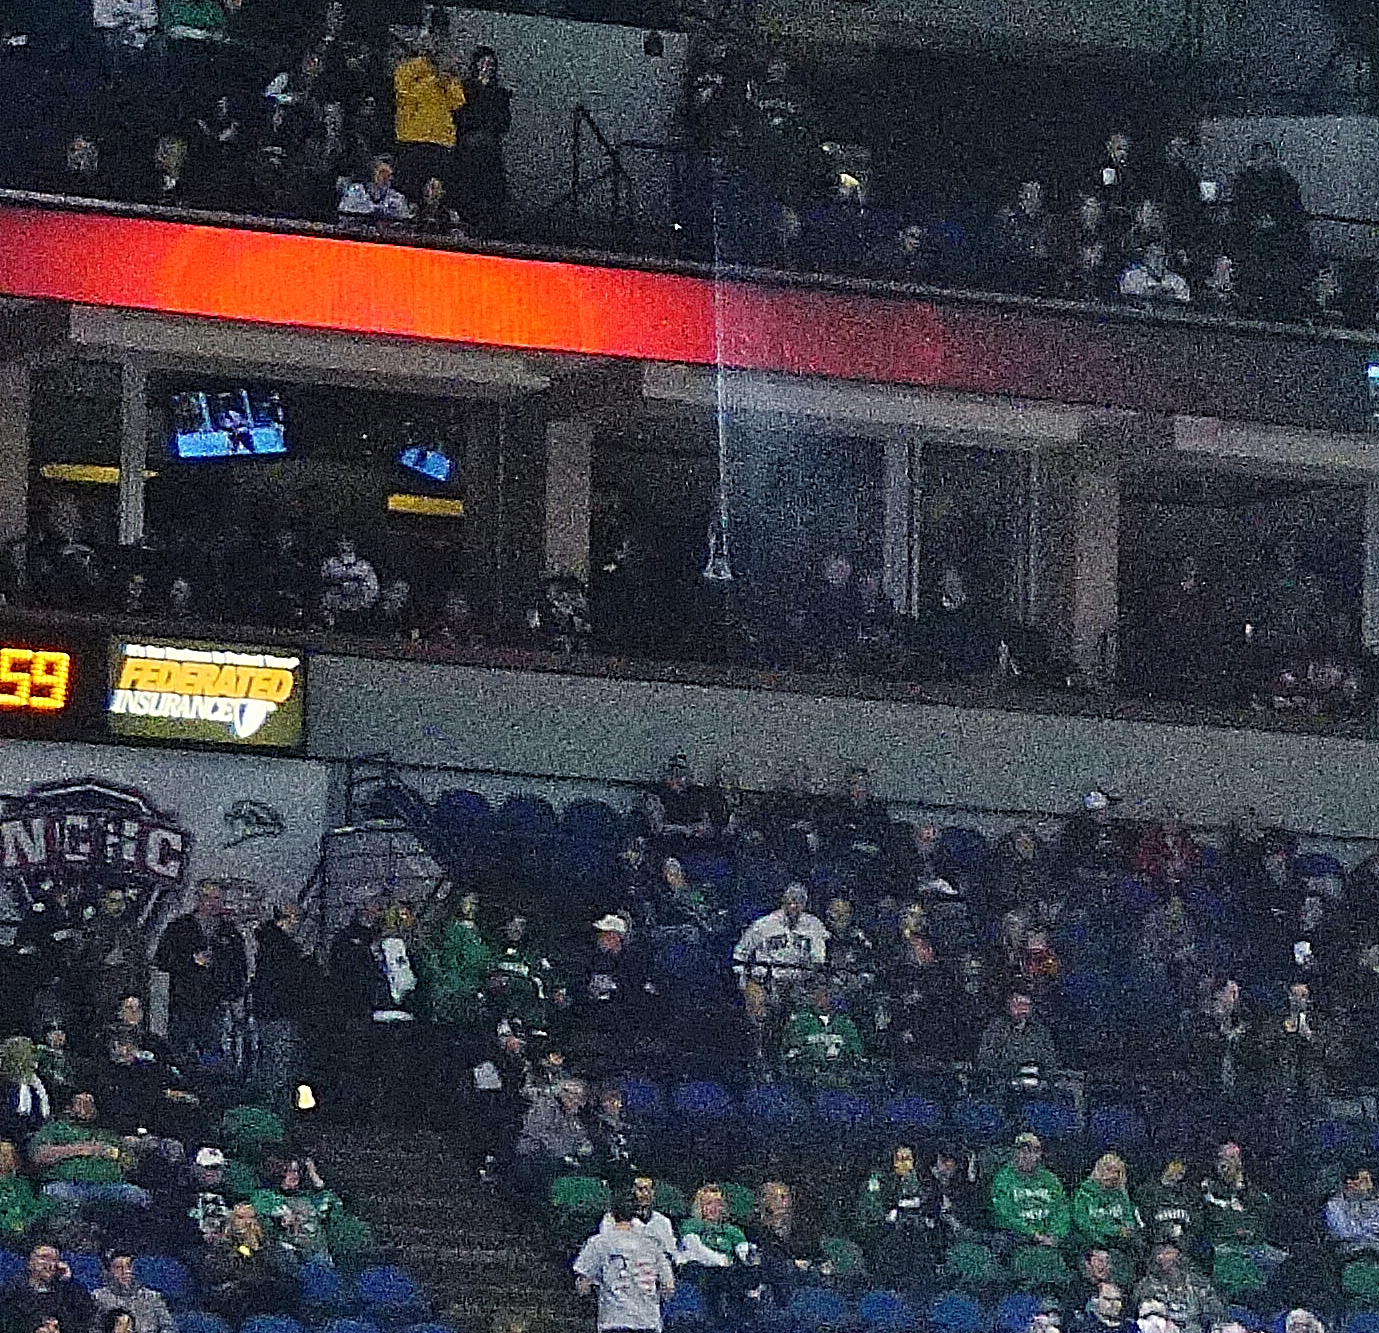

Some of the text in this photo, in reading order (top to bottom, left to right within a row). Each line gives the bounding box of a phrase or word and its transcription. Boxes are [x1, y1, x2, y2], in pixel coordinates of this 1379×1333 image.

[0, 648, 70, 710] 59
[119, 657, 295, 703] FEDERATED
[111, 689, 237, 722] INSURANCE
